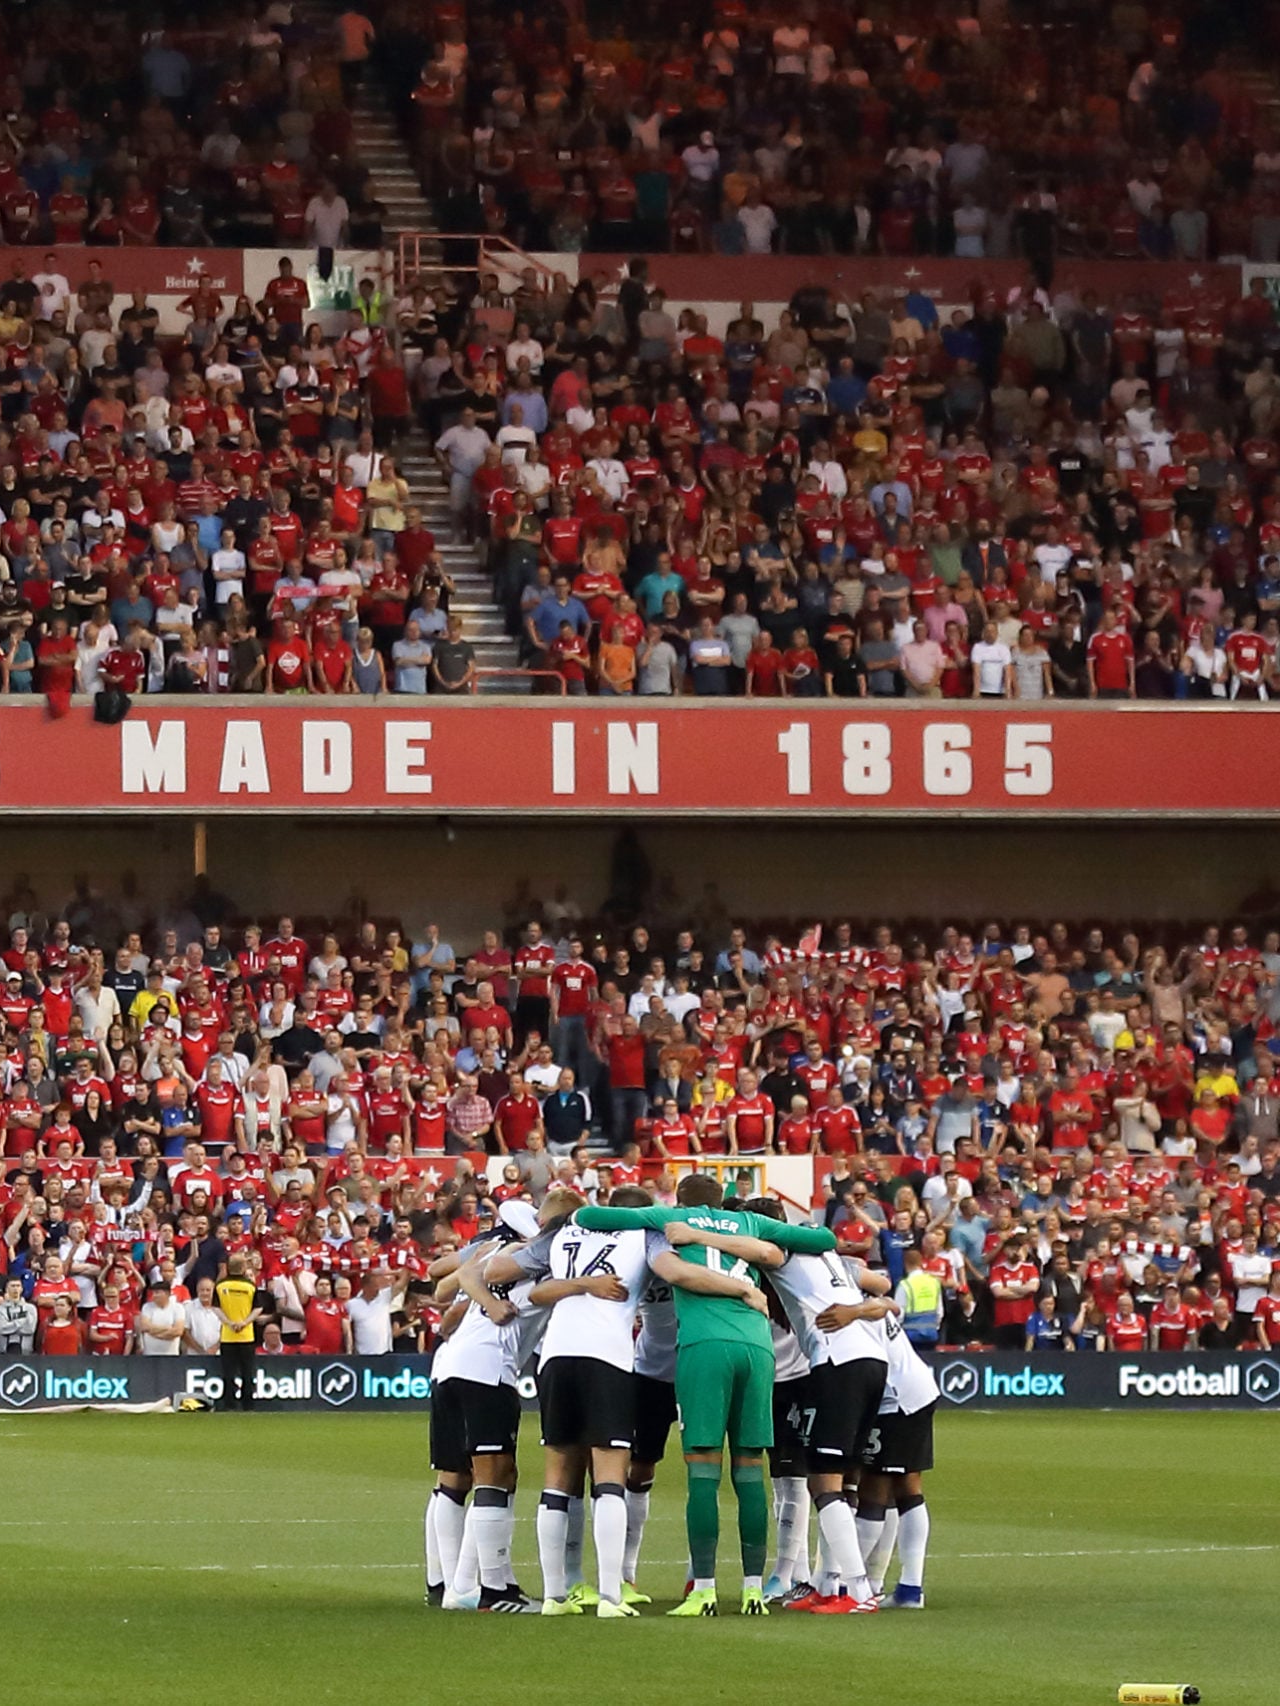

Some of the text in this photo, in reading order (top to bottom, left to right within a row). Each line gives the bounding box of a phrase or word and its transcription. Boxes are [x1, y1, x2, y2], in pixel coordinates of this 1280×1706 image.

[165, 276, 226, 289] Heinen
[121, 719, 433, 794] MADE
[552, 721, 660, 795] IN
[777, 722, 1054, 796] 1865
[45, 1369, 129, 1399] Index
[186, 1367, 433, 1399] Foball Inde
[984, 1366, 1065, 1397] Index
[1119, 1365, 1240, 1397] Football
